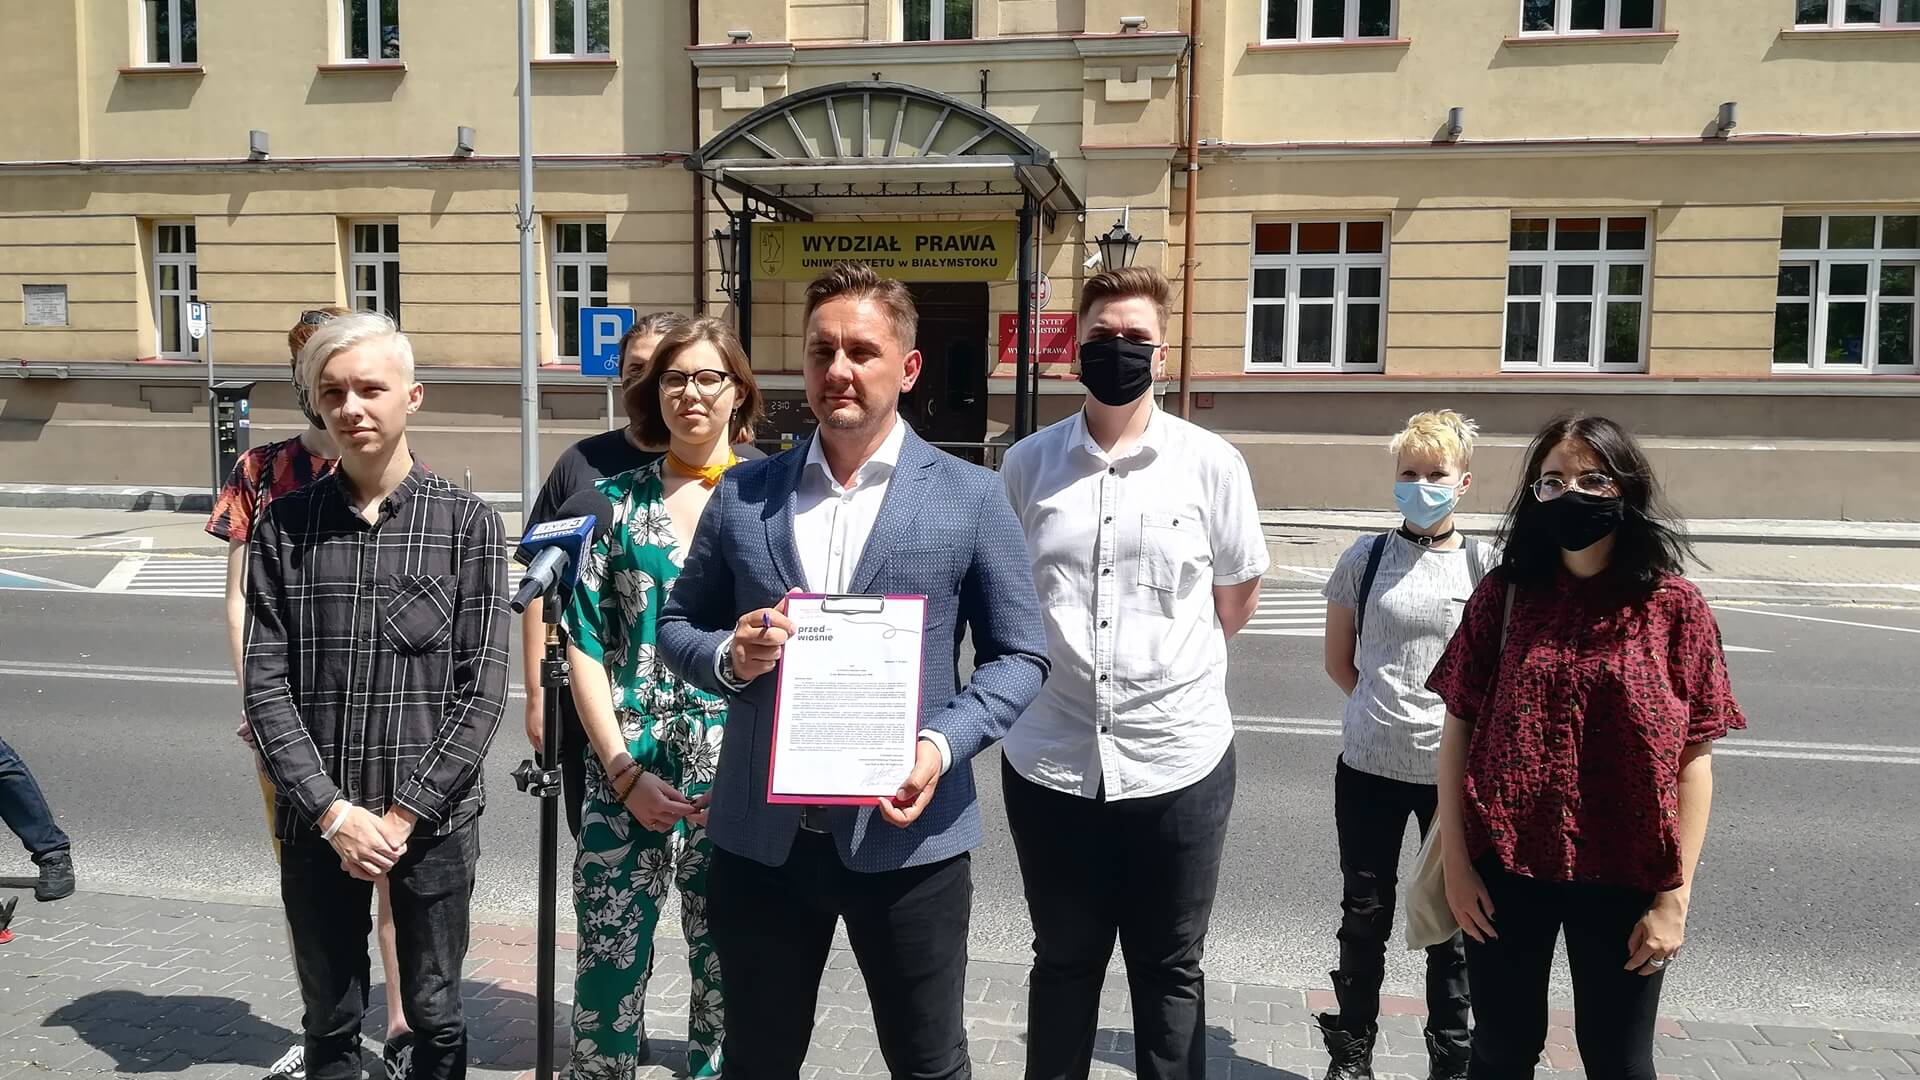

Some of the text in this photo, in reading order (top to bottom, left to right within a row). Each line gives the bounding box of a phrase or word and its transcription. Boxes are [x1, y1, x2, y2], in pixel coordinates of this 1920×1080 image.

[802, 234, 996, 252] WYDZIAŁ PRAWA
[912, 257, 998, 267] BIAŁYMSTOKU
[593, 314, 622, 356] P
